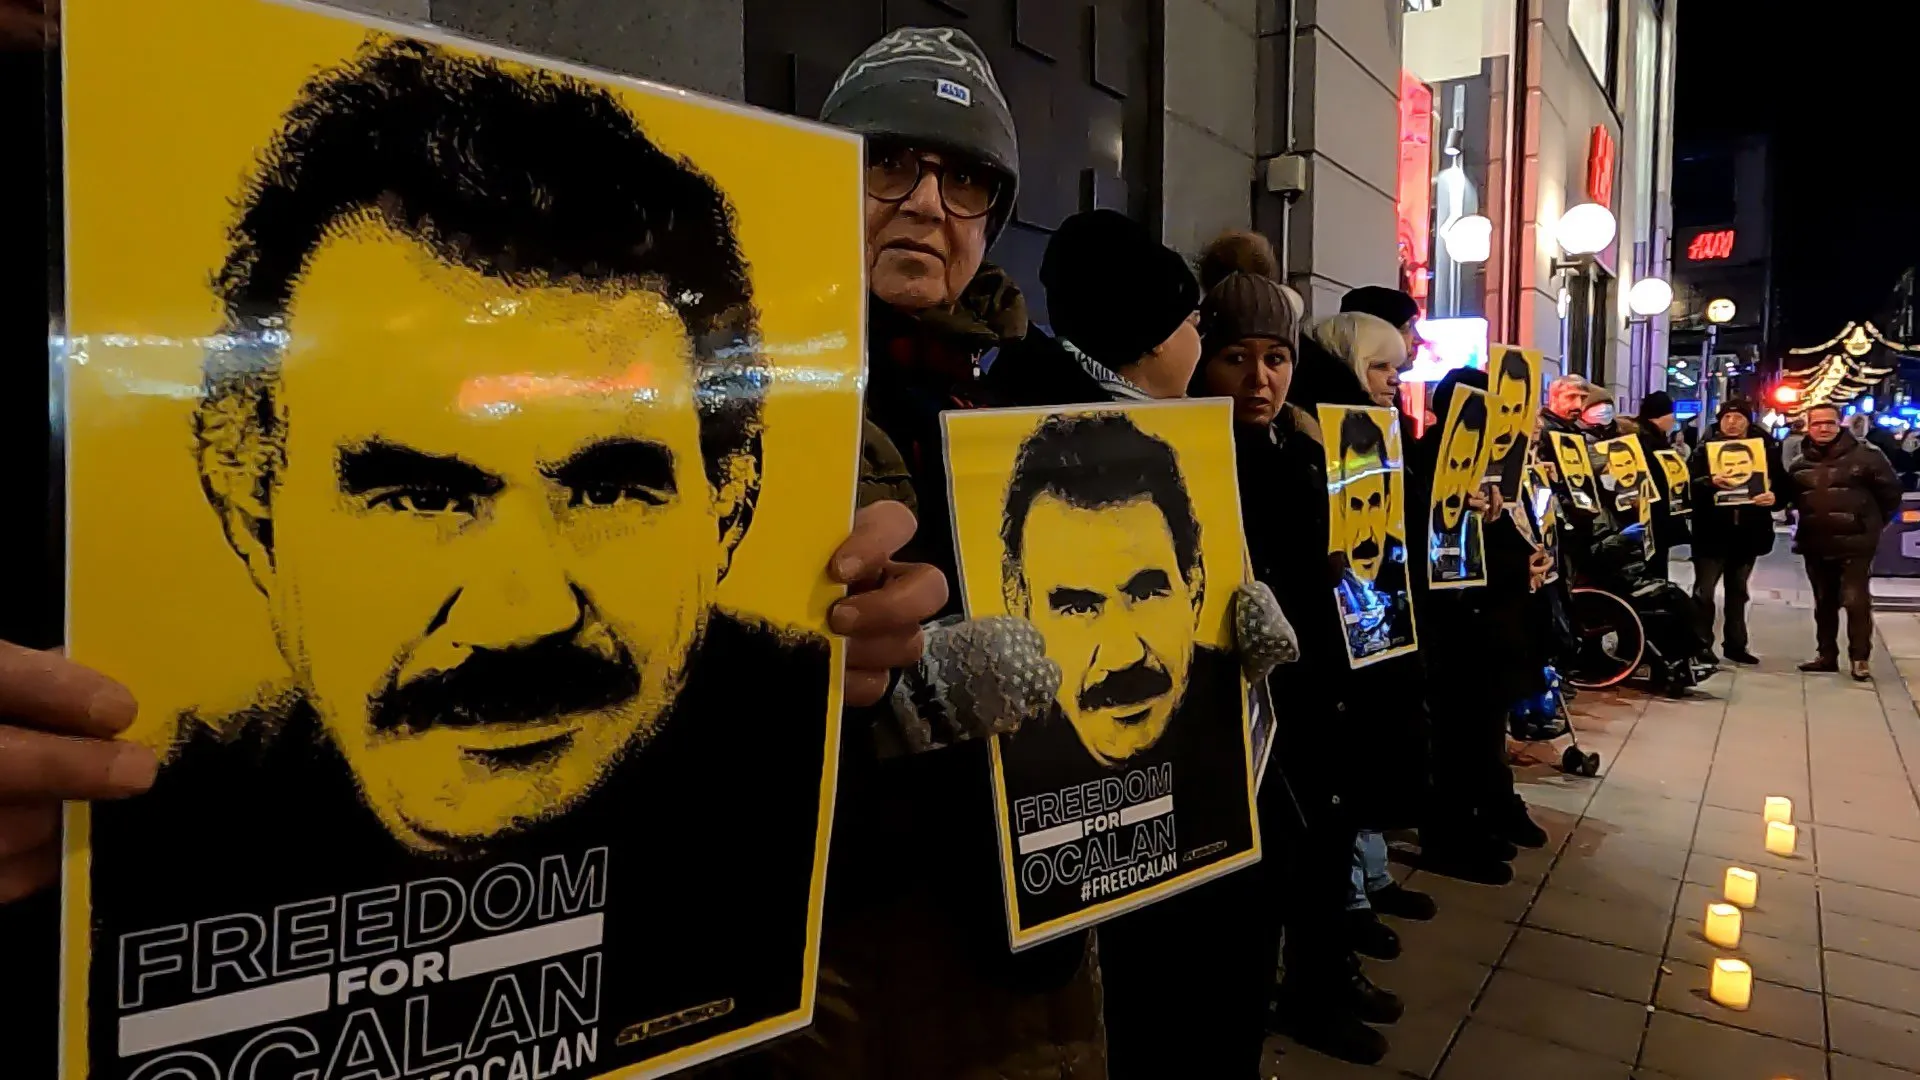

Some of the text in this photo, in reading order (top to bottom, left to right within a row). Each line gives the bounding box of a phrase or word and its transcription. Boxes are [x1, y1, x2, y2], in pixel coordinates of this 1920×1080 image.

[1014, 762, 1173, 833] FREEDOM
[1083, 811, 1121, 836] FOR
[1022, 814, 1176, 895] OCALAN
[1080, 852, 1177, 901] #FREEOCALAN
[118, 846, 609, 1009] FREEDOM
[336, 956, 449, 1006] FOR
